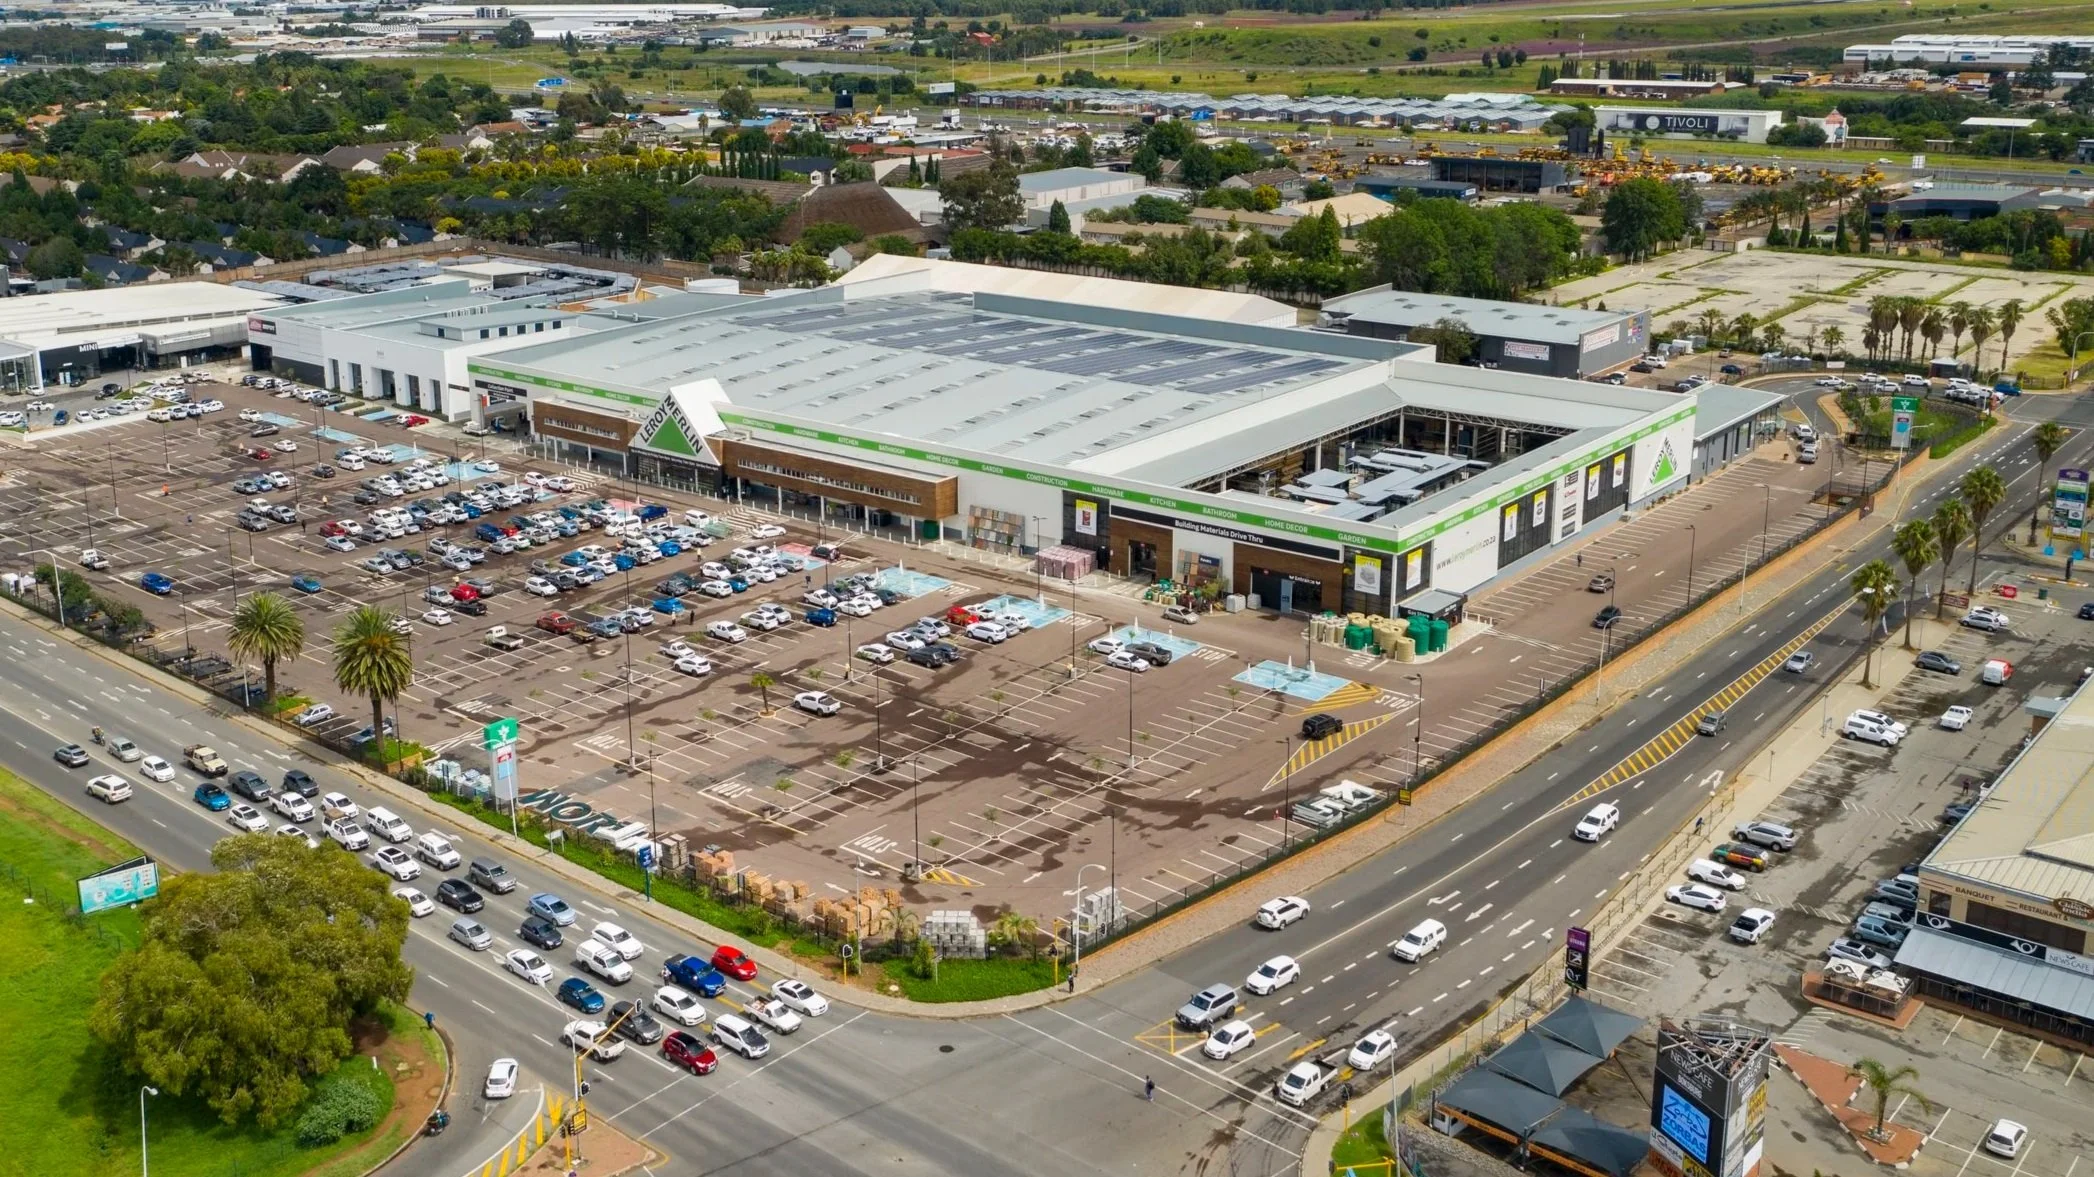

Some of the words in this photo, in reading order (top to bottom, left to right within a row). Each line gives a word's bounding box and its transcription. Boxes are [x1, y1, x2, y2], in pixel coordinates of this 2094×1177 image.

[1665, 116, 1708, 129] TIVOLI
[79, 343, 99, 353] MINI
[640, 403, 668, 443] LEROY
[664, 395, 703, 454] MERLIN
[1650, 449, 1665, 483] LEROY
[1664, 436, 1678, 472] MERLIN
[838, 436, 859, 446] KITCHEN
[926, 453, 941, 463] HOME
[941, 456, 959, 466] DECOR
[981, 464, 1004, 475] GARDEN
[1026, 473, 1068, 487] CONSTRUCTION
[1092, 486, 1125, 498] HARDWARE
[1150, 497, 1177, 508] KITCHEN
[1203, 506, 1237, 520] BATHROOM
[1265, 519, 1285, 530] HOME
[1285, 521, 1308, 533] DECOR
[1338, 533, 1367, 545] GARDEN
[1175, 519, 1199, 532] Building
[1200, 524, 1230, 538] Materials
[1230, 529, 1247, 540] Drive
[1248, 532, 1264, 543] Thru
[1374, 694, 1414, 710] STOP
[1955, 887, 1995, 902] BANQUET
[2019, 903, 2062, 920] RESTAURANT
[2049, 954, 2070, 966] NEWS
[2070, 960, 2090, 973] CAFE
[1662, 1113, 1706, 1154] ZORBAS
